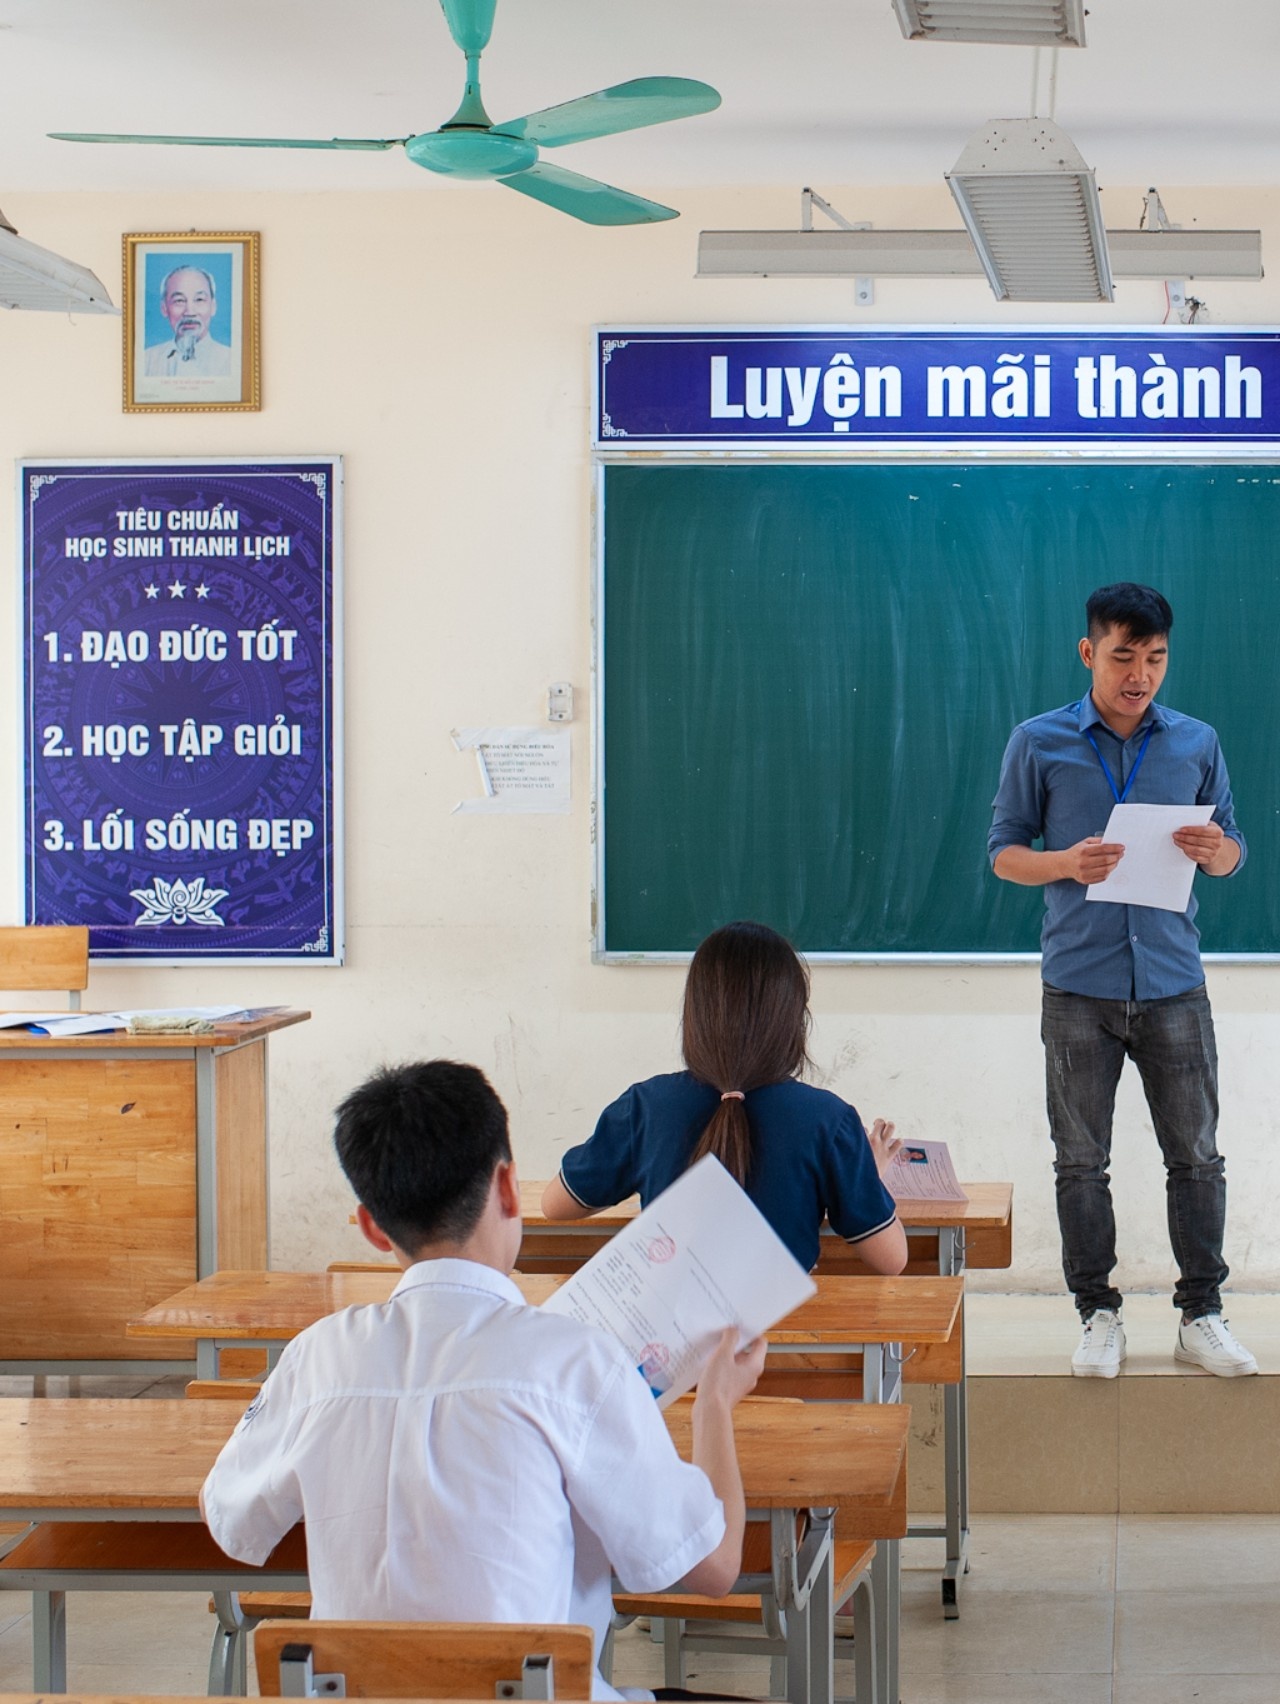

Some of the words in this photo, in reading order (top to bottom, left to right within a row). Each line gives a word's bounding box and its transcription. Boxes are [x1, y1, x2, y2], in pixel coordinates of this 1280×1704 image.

[709, 353, 902, 432] Luyện
[925, 352, 1052, 420] mãi
[1074, 353, 1263, 420] thành
[115, 506, 161, 531] TIÊU
[167, 502, 239, 531] CHUẨN
[64, 537, 107, 562] HỌC
[113, 537, 163, 558] SINH
[168, 536, 238, 557] THANH
[243, 536, 290, 561] LỊCH
[43, 631, 73, 663] 1.
[80, 630, 149, 669] ĐẠO
[158, 623, 227, 662] ĐỨC
[237, 618, 298, 662] TỐT
[42, 725, 73, 757] 2.
[82, 724, 149, 763] HỌC
[159, 718, 223, 763] TẬP
[234, 714, 302, 757] GIỎI
[43, 819, 74, 851] 3.
[83, 808, 134, 851] LỐI
[145, 808, 237, 851] SỐNG
[247, 818, 314, 857] ĐẸP
